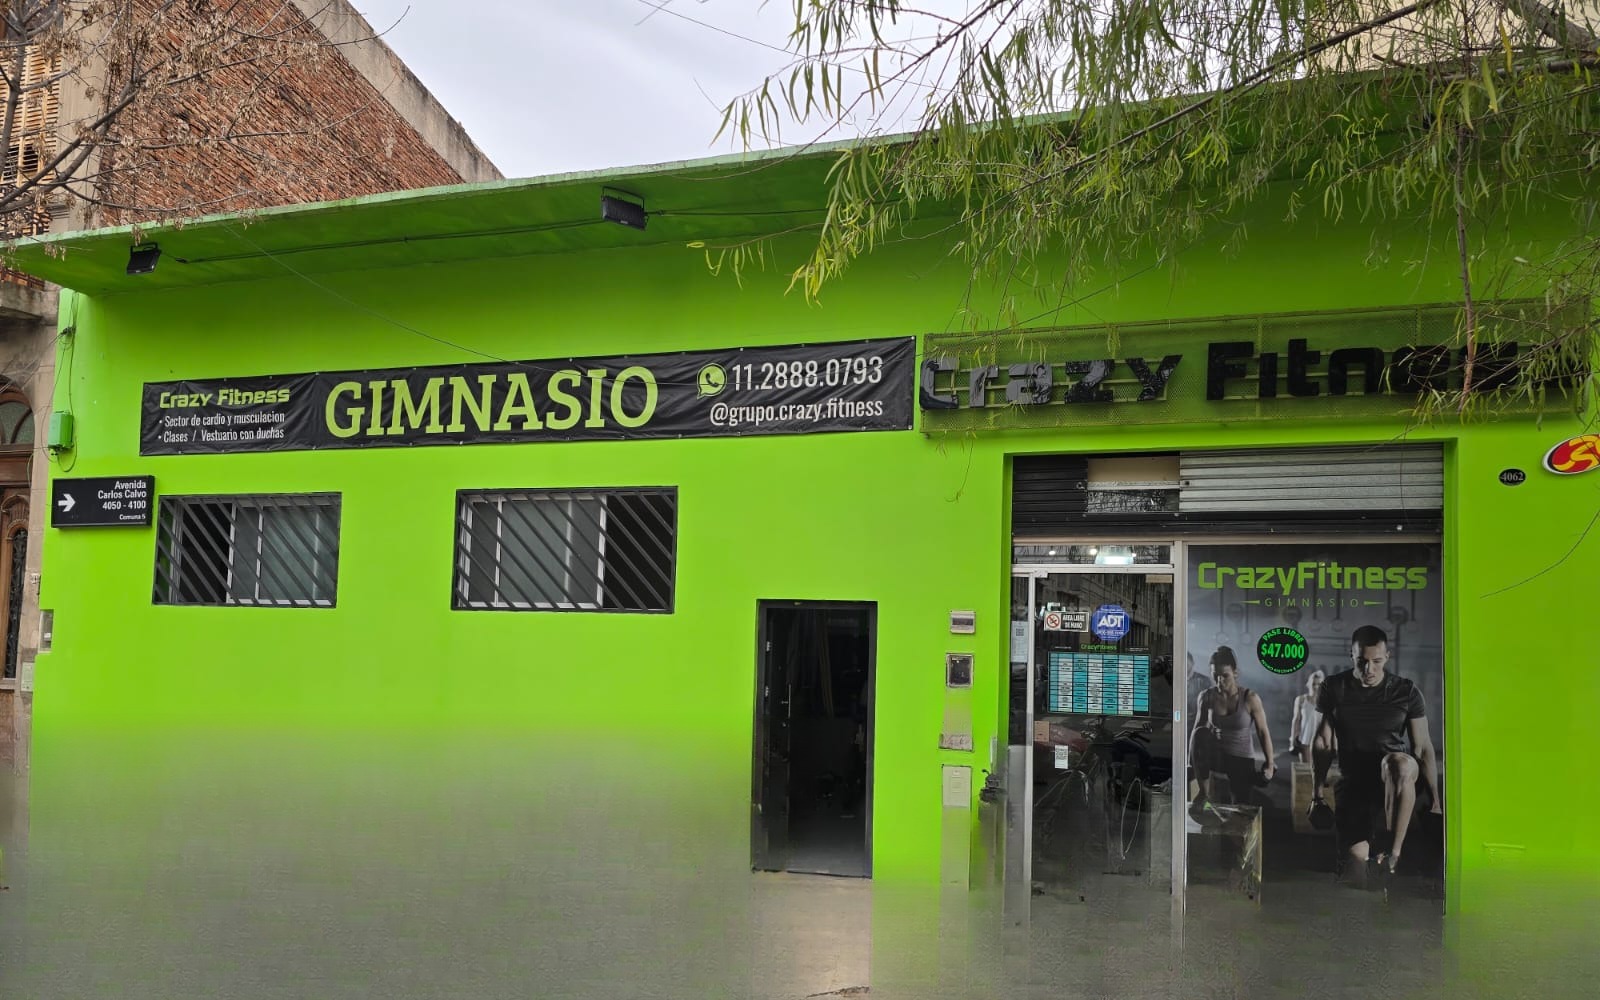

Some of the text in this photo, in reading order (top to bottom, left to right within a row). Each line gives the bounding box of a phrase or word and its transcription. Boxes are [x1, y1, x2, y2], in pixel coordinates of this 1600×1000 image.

[732, 356, 883, 392] 11.2888.0793
[919, 354, 1183, 409] Crazy
[159, 388, 290, 409] Crazy Fitness
[324, 366, 659, 438] GIMNASIO
[164, 411, 285, 427] Sector de cardio y musculacion
[710, 398, 883, 426] @grupo.crazy.fitness
[163, 431, 188, 443] Clases
[201, 429, 238, 442] Vestuario
[239, 430, 254, 440] con
[256, 427, 285, 440] duchas
[1500, 472, 1524, 481] 4062
[114, 480, 147, 490] Avenida
[97, 489, 147, 499] Carlos Calvo
[102, 501, 121, 510] 4050
[128, 500, 146, 509] 4100
[1198, 561, 1428, 596] CrazyFitness
[1265, 598, 1359, 608] GIMNASIO
[1097, 615, 1124, 628] ADT
[1263, 629, 1280, 641] PASE
[1261, 643, 1305, 659] $47.000
